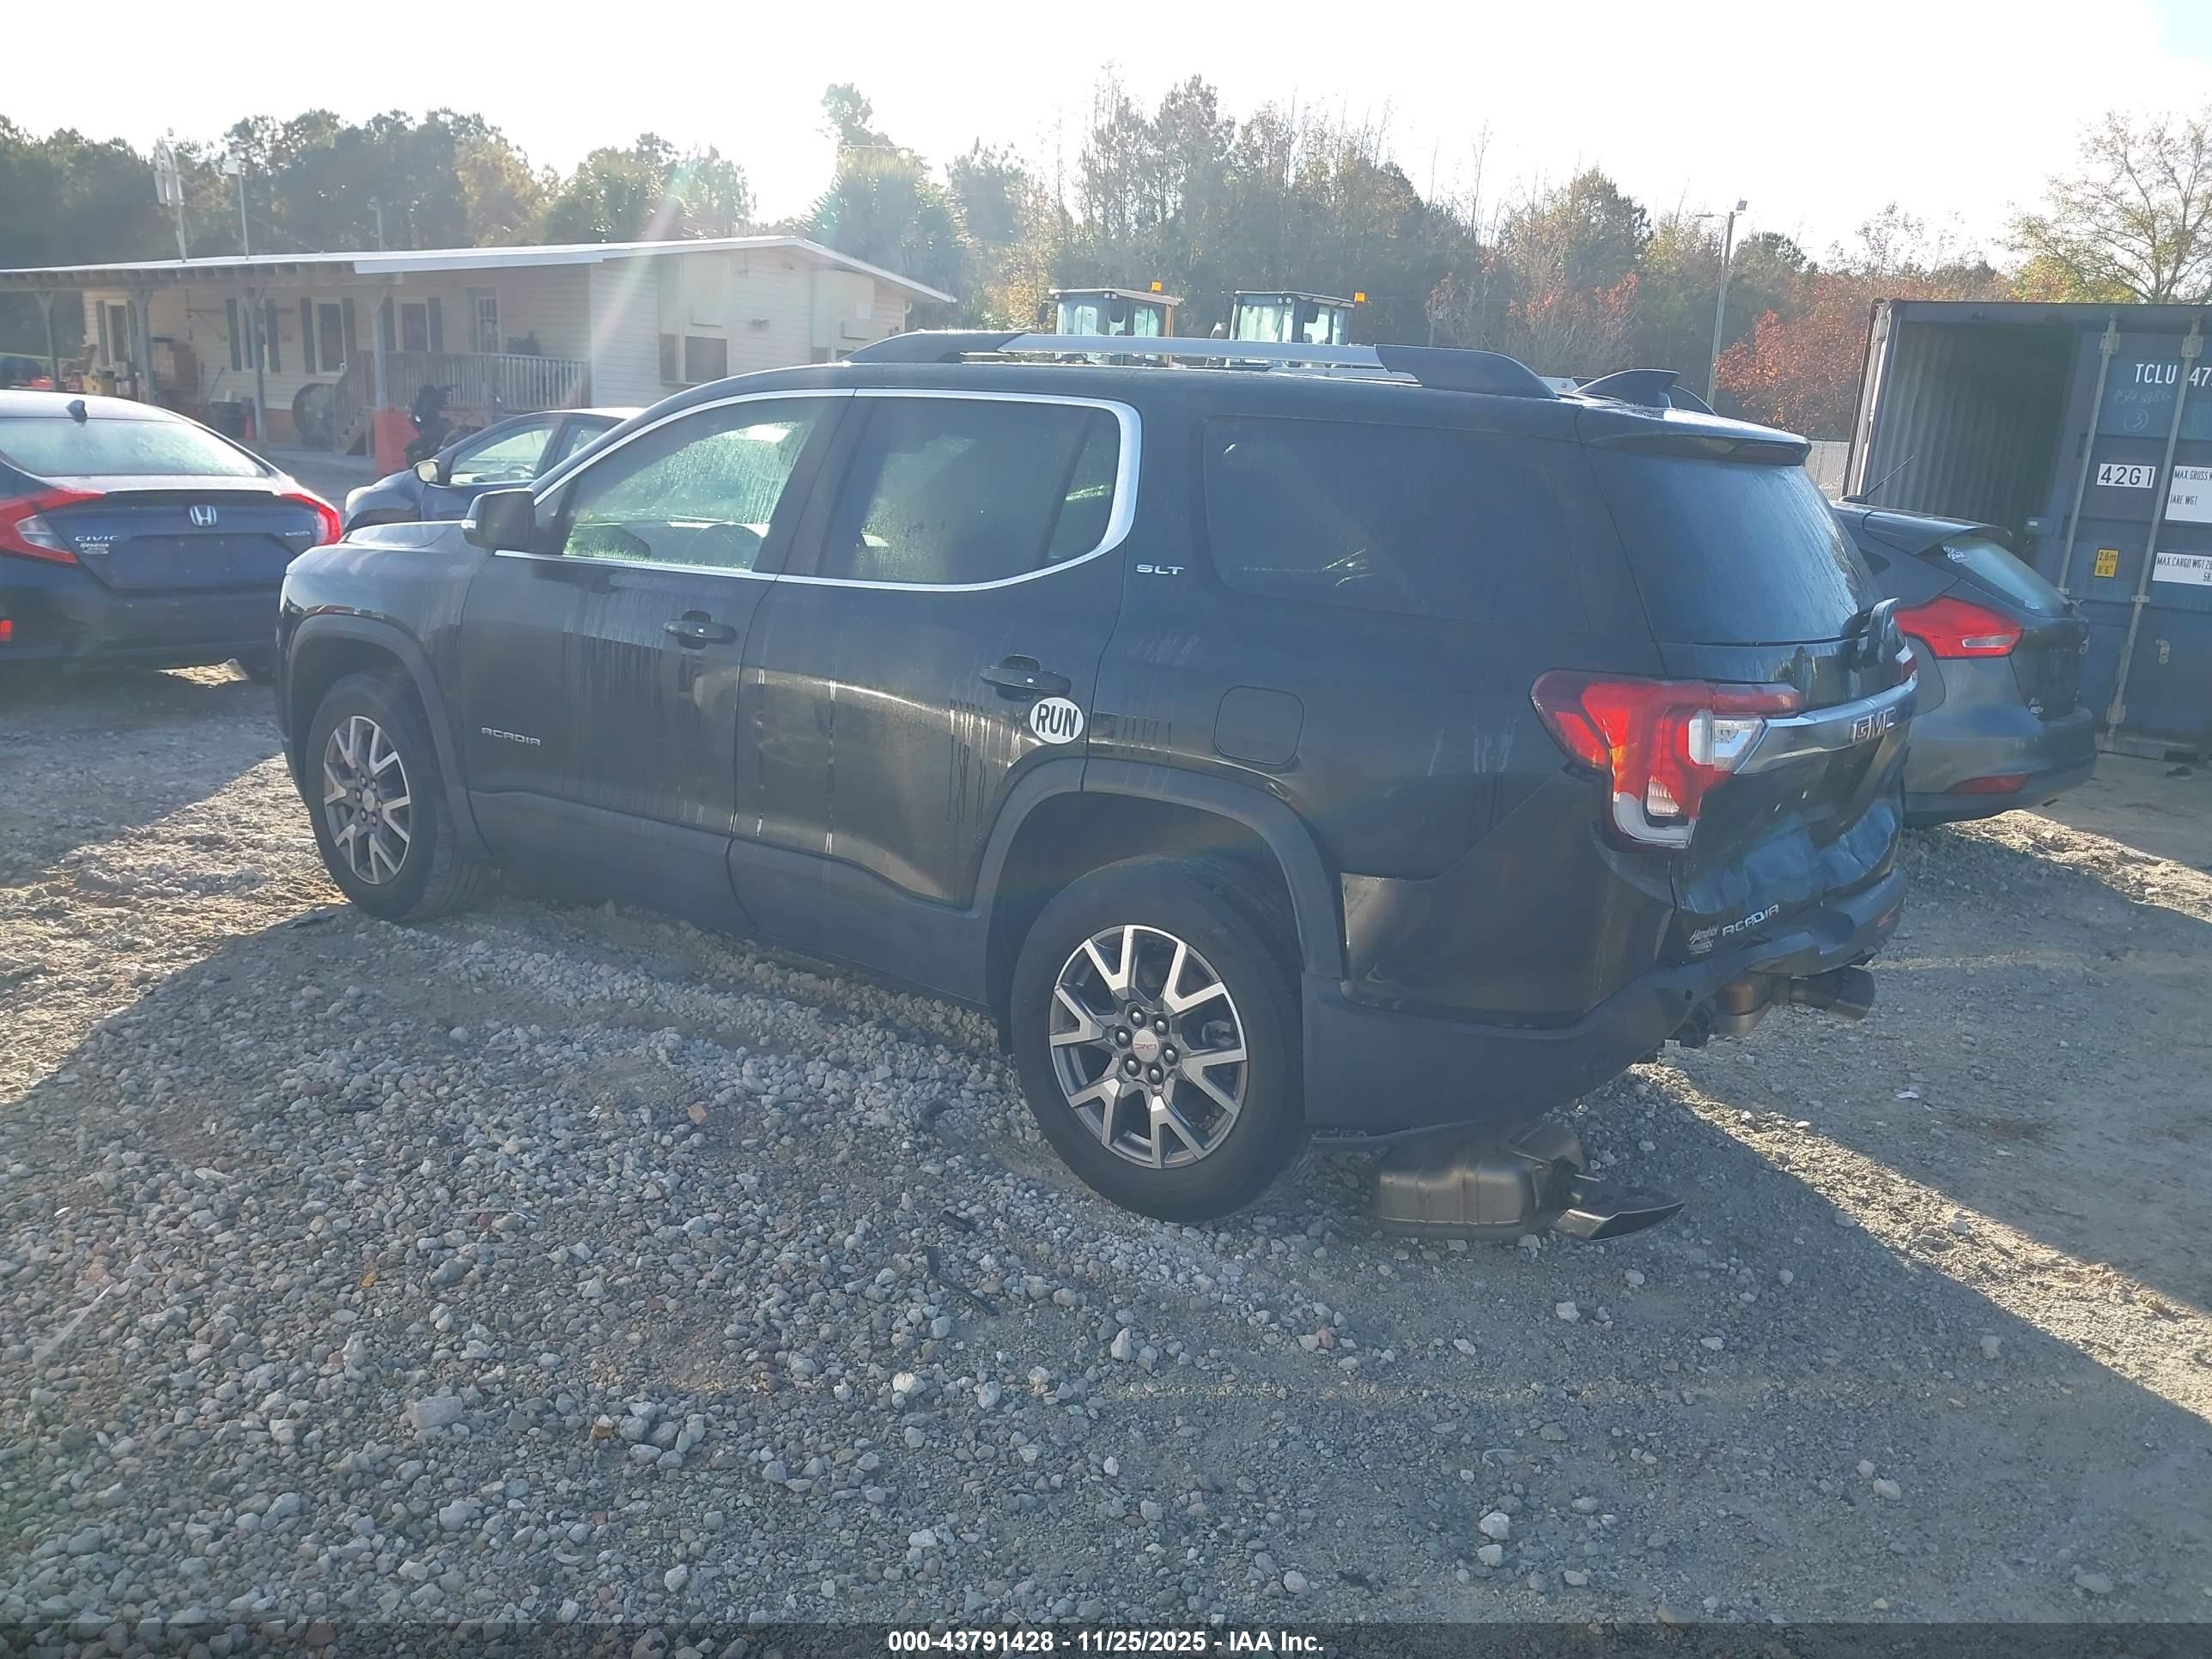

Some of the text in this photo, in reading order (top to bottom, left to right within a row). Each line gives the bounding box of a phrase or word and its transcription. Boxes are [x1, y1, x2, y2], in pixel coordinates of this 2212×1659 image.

[2136, 363, 2212, 386] TCLU 47
[2100, 465, 2153, 486] 42G1
[2174, 470, 2189, 480] MAX
[2190, 470, 2209, 481] GROSS
[2185, 495, 2198, 506] WGT
[1136, 564, 1185, 575] SLT
[2156, 556, 2172, 567] MAX
[2172, 557, 2191, 568] CARGO
[2192, 559, 2205, 569] WGT
[1036, 703, 1079, 738] RUN
[1851, 706, 1897, 743] GMC
[481, 726, 542, 746] ACADIA
[1722, 903, 1779, 937] ACADIA
